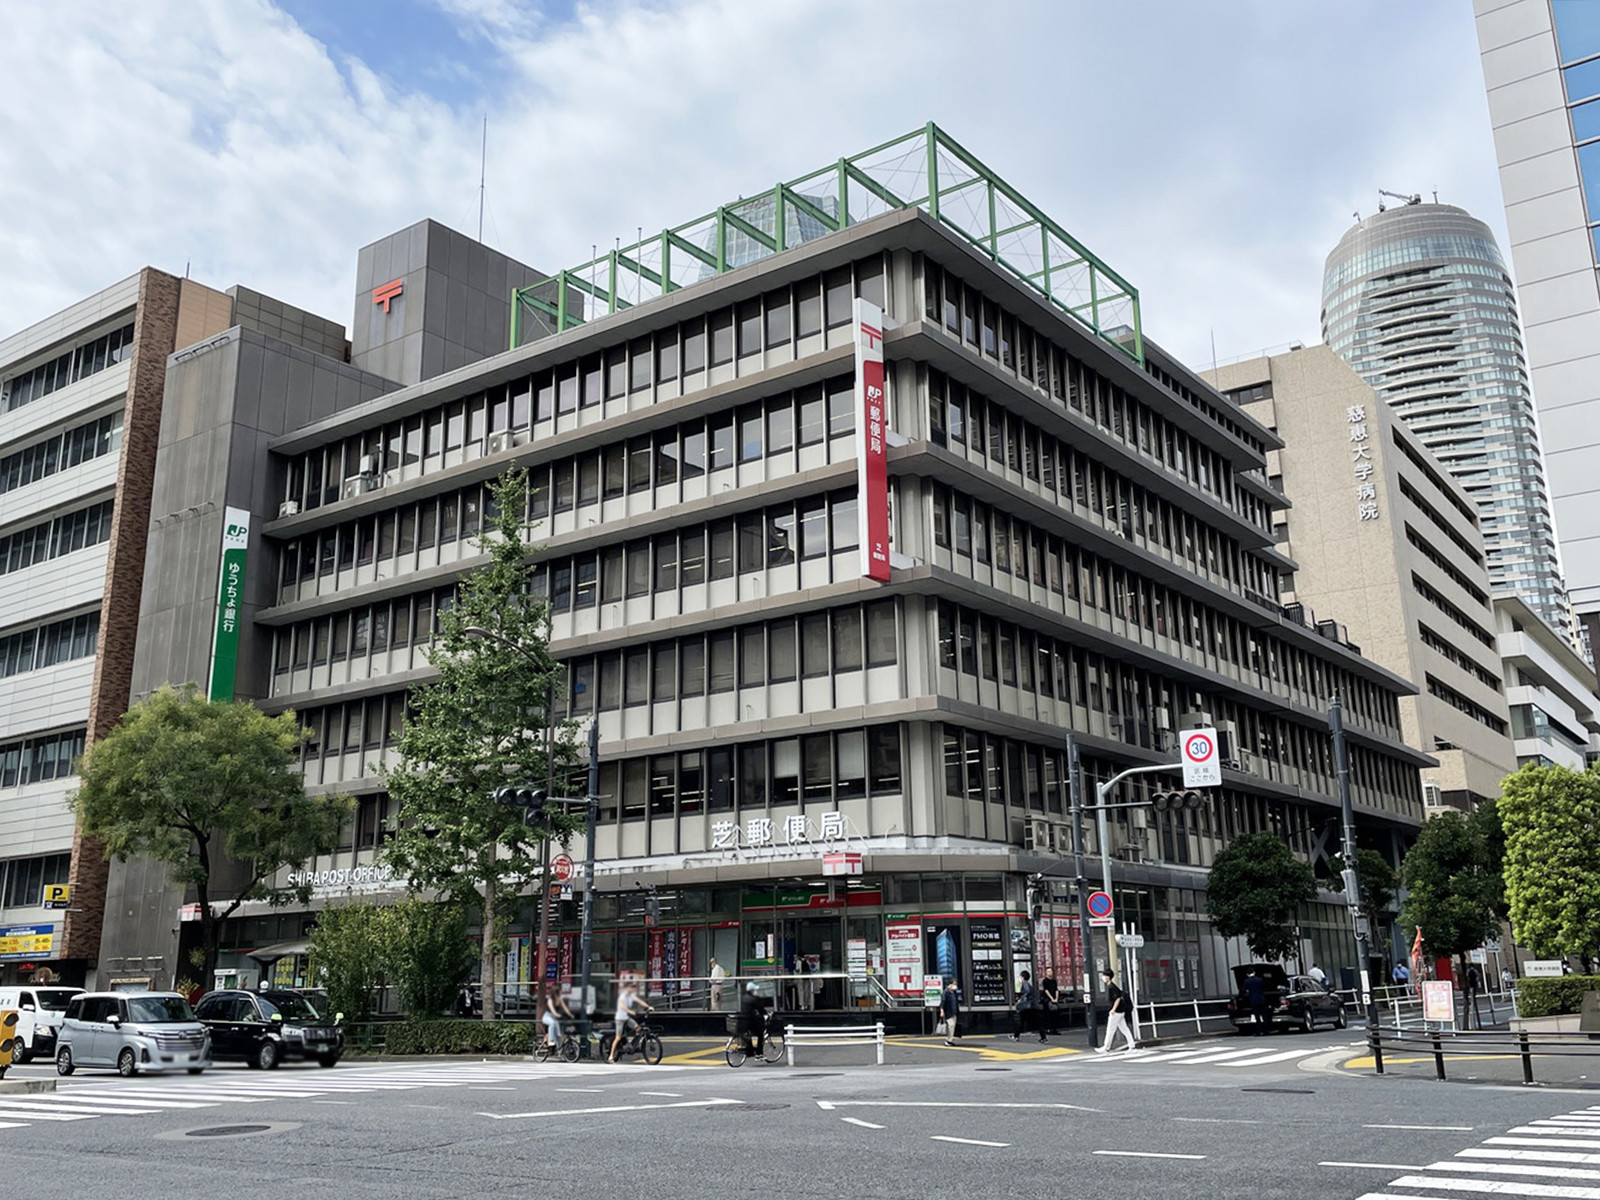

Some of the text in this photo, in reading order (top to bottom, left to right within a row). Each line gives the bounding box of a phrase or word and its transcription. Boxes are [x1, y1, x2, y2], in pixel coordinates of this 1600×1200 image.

[869, 405, 881, 454] 郵便局
[1346, 404, 1379, 521] 慈恵大学病院
[223, 562, 240, 632] ゆうちょ銀行
[1191, 741, 1207, 755] 30
[711, 811, 844, 848] 芝郵便局
[52, 887, 63, 899] P
[287, 869, 320, 887] SHIBA
[321, 868, 352, 884] POST
[680, 931, 688, 971] レターパック
